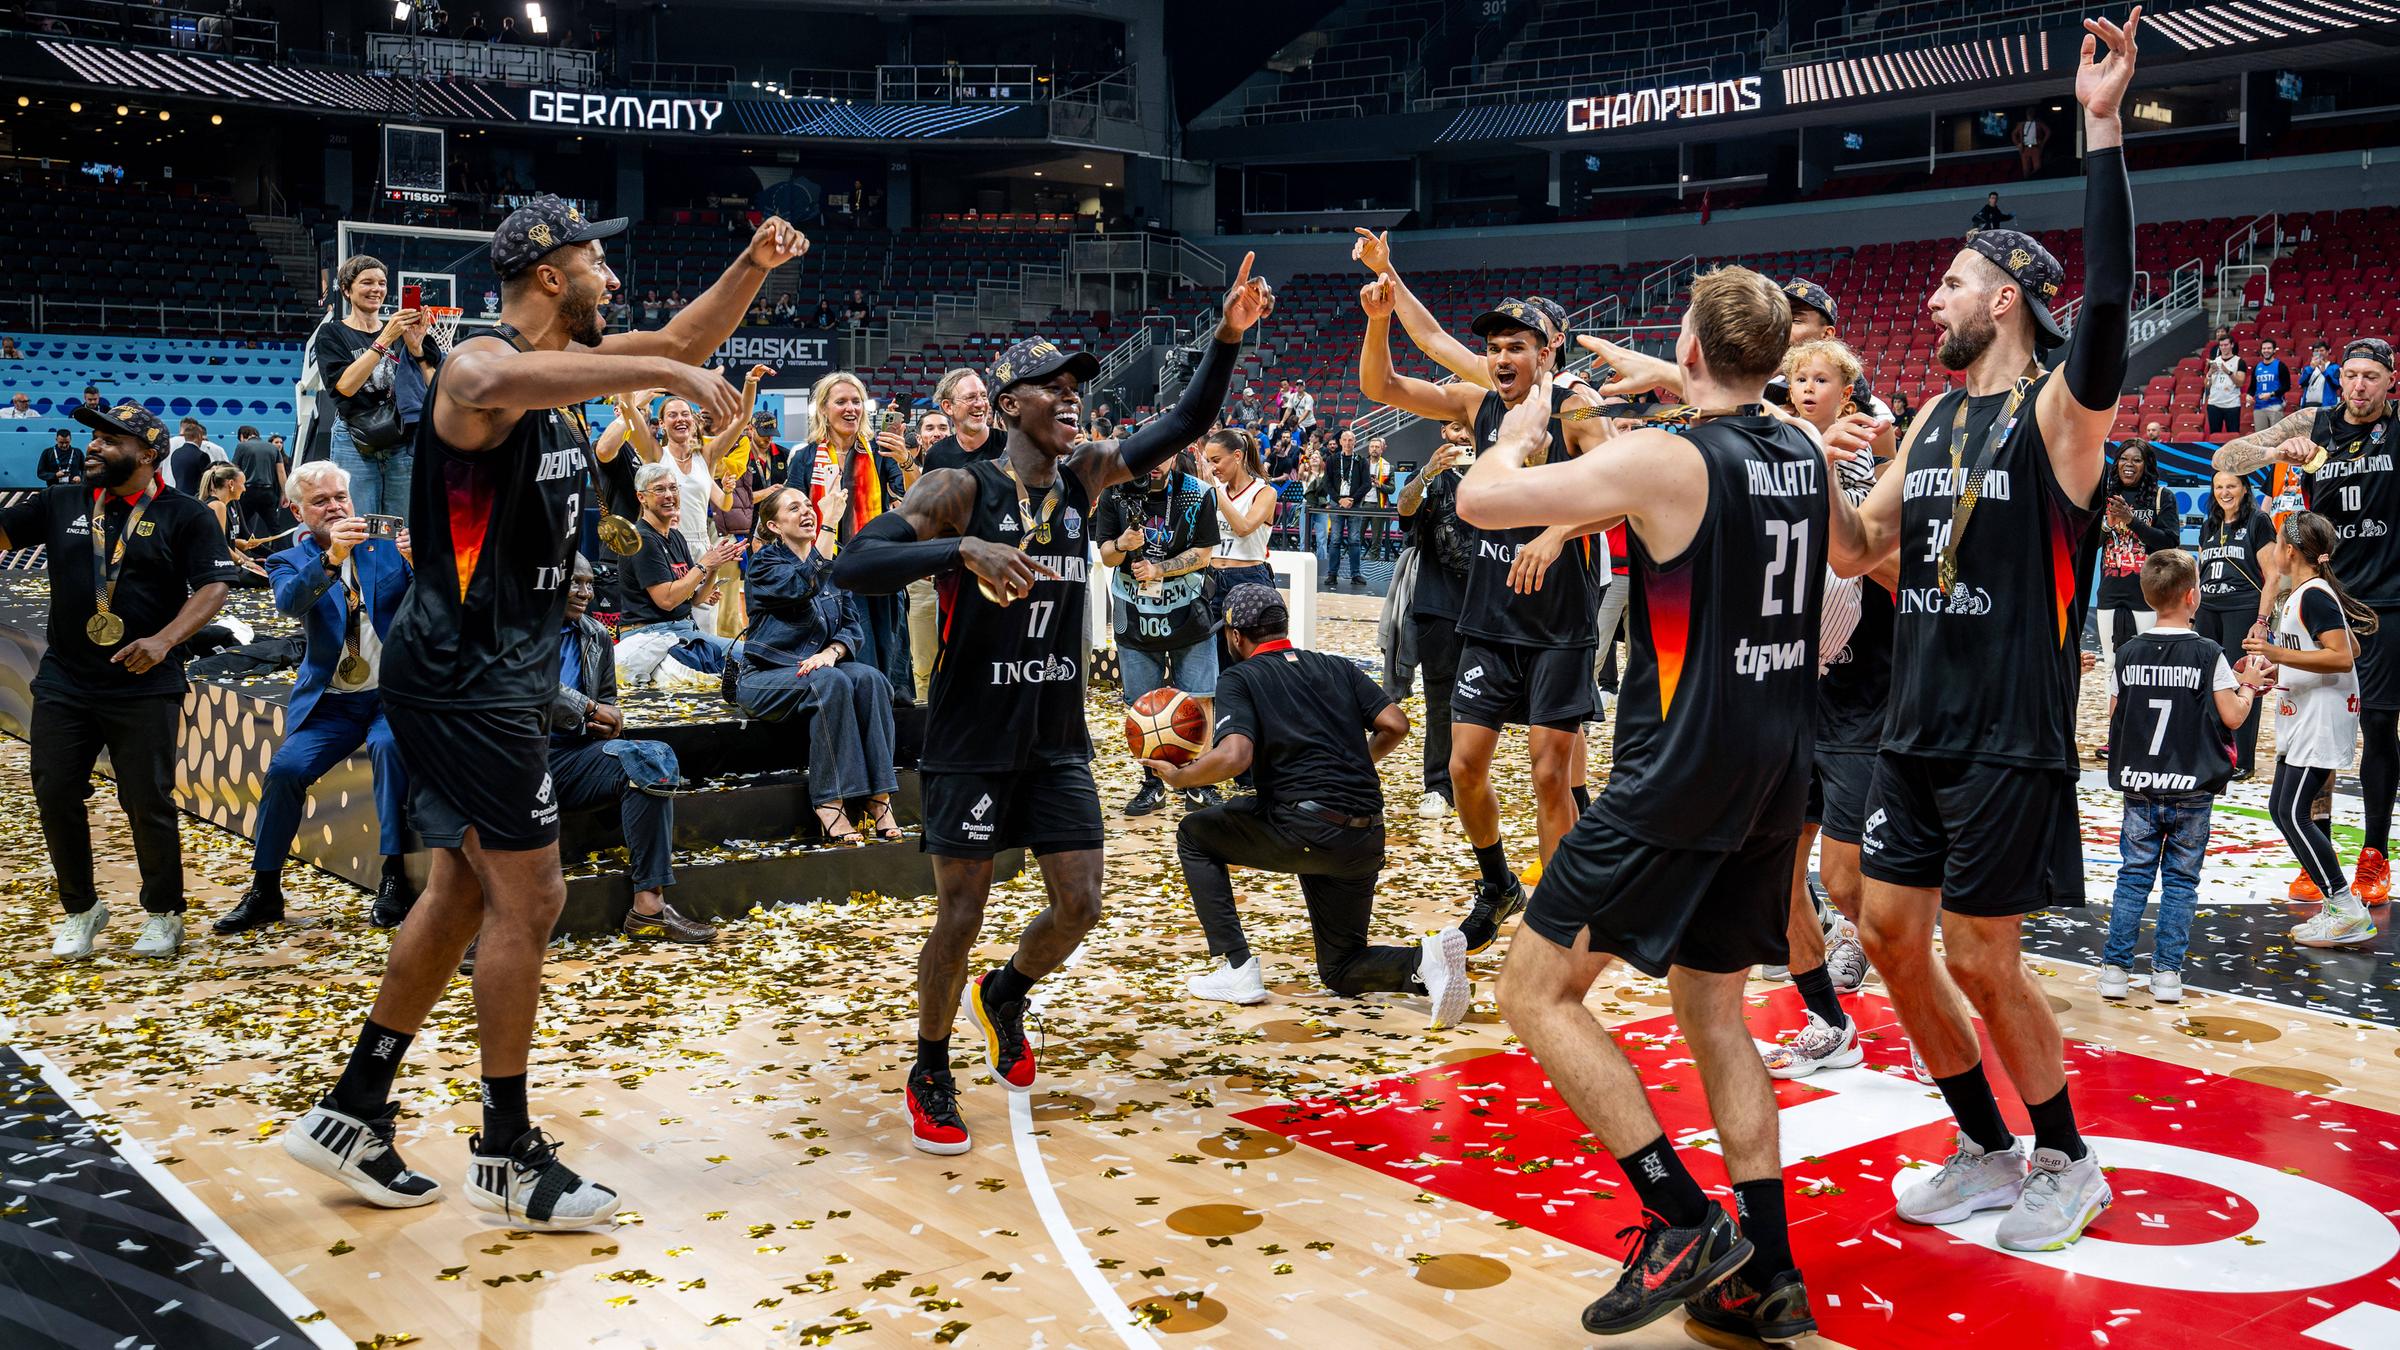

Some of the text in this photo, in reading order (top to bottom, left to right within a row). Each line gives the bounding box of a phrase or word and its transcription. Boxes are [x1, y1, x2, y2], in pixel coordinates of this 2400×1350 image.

[530, 90, 723, 131] GERMANY
[1567, 76, 1761, 132] CHAMPIONS
[402, 192, 447, 203] TISSOT
[1744, 459, 1817, 497] HOLLATZ
[2339, 486, 2361, 511] 10
[2335, 525, 2357, 540] NG
[1478, 539, 1511, 563] ING
[1761, 518, 1809, 616] 21
[2210, 561, 2224, 579] 10
[1900, 587, 1945, 614] ING
[1027, 600, 1055, 638] 17
[1139, 616, 1172, 637] 008
[991, 660, 1045, 685] ING
[2148, 698, 2173, 756] 7
[2120, 765, 2197, 792] tipwin
[1639, 1149, 1670, 1185] PEAK
